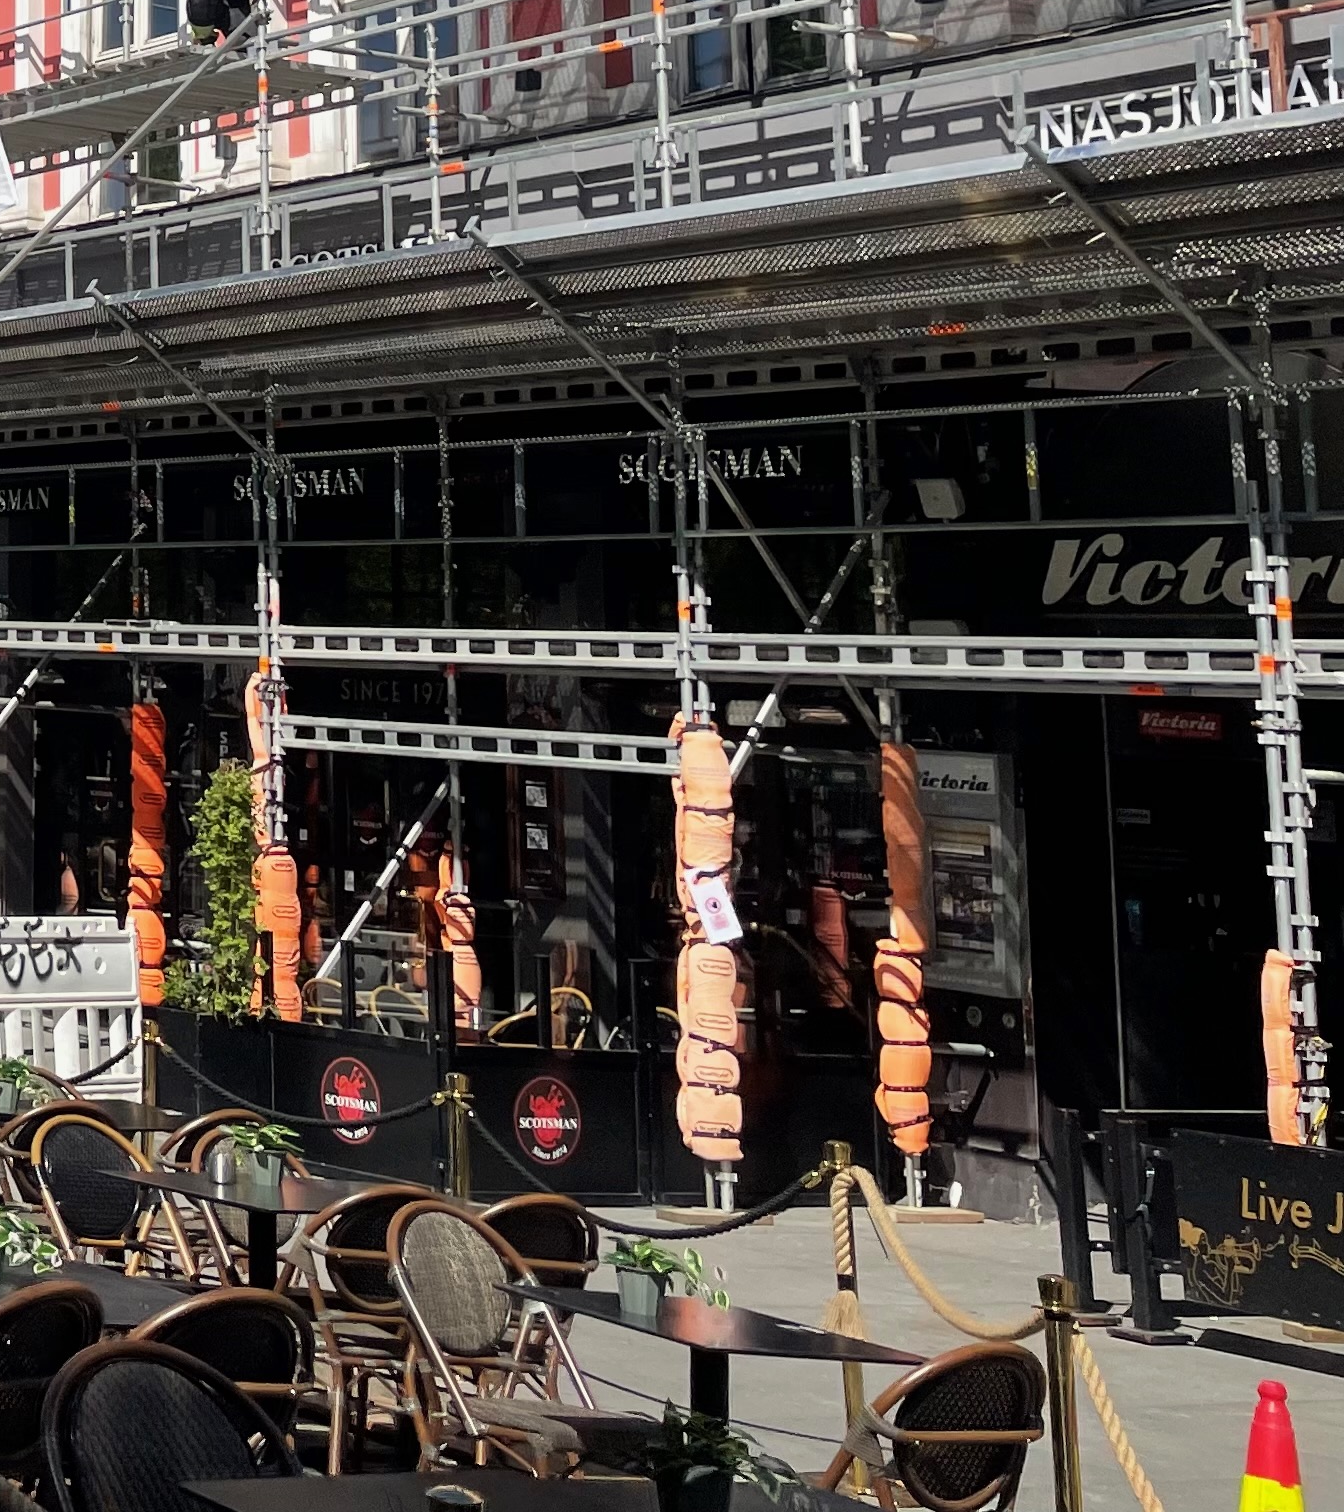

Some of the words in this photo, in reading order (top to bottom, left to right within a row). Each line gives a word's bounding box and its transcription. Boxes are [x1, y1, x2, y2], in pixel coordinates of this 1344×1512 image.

[340, 678, 401, 703] SINCE
[413, 681, 445, 705] 197
[1140, 711, 1217, 732] Victoria
[918, 770, 989, 792] ictoria
[324, 1092, 378, 1113] SCOTSMAN
[518, 1116, 578, 1130] SCOTSMAN
[1241, 1176, 1313, 1229] Live
